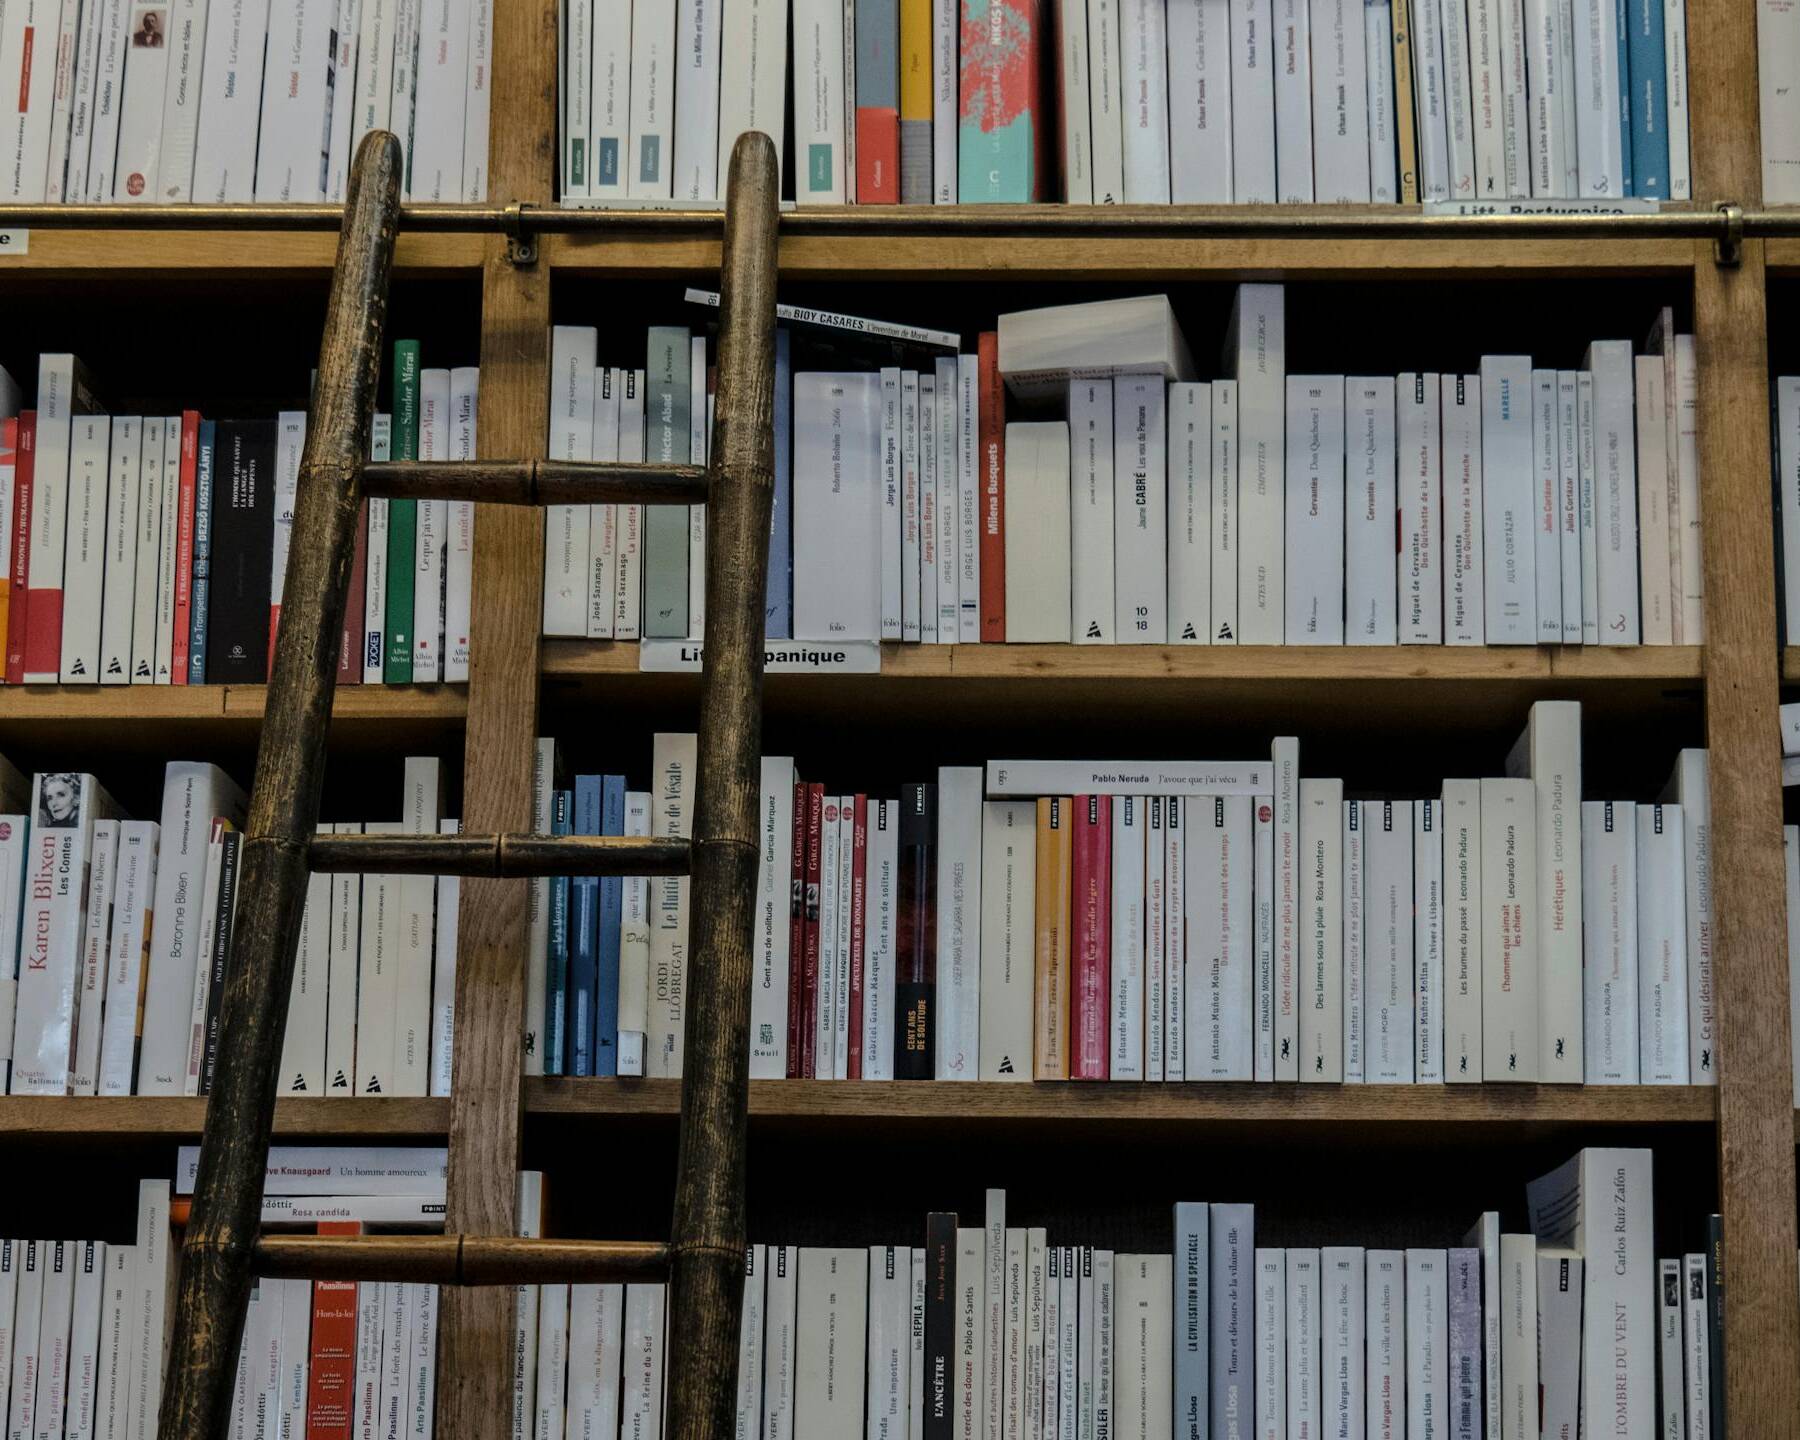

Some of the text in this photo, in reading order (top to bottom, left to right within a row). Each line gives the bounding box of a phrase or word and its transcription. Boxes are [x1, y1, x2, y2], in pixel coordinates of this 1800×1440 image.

[793, 308, 864, 330] BIOY CASARES
[401, 352, 414, 424] Sándor Márai
[661, 394, 673, 462] Héctor Abad
[886, 437, 895, 464] Borges
[199, 446, 211, 509] KOSZTOLÁNYI
[233, 461, 241, 474] QUI
[988, 444, 1000, 534] Milena Busquets
[1135, 473, 1146, 505] CABRÉ
[1501, 379, 1514, 555] CORTÁZAR MARELLE
[886, 484, 895, 506] Jorge
[628, 506, 636, 553] La lucidité
[924, 492, 934, 563] Jorge Luis Borges
[196, 543, 211, 577] tchèque
[1411, 533, 1421, 624] Miguel de Cervantes
[195, 579, 209, 633] Trompettiste
[592, 557, 604, 620] José Saramago
[1136, 607, 1148, 616] 10
[194, 635, 204, 645] Le
[369, 632, 379, 667] POCKET
[1136, 621, 1148, 630] 18
[764, 649, 845, 664] panique
[662, 763, 681, 818] de Vésale
[1092, 774, 1149, 783] Pablo Neruda
[57, 837, 72, 895] Les Contes
[1315, 840, 1324, 878] Montero
[1506, 826, 1516, 898] Leonardo Padura
[1551, 774, 1565, 931] Hérétiques Leonardo Padura
[29, 836, 55, 970] Karen Blixen
[1281, 760, 1293, 1015] L'idée ridicule de ne plus jamais te revoir Rosa Montero
[1315, 881, 1324, 901] Rosa
[1458, 828, 1470, 995] Les brumes du passé Leonardo Padura
[170, 872, 188, 958] Baronne Blixen
[1315, 907, 1326, 928] pluie
[1512, 904, 1521, 947] les chiens
[1695, 825, 1713, 1040] Ce qui désirait arriver Leonardo Padura
[86, 937, 98, 990] Karen Blixen
[765, 938, 772, 948] de
[1501, 905, 1514, 992] L'homme qui aimait
[657, 962, 669, 1001] JORDI
[670, 943, 682, 1021] LLOBREGAT
[1261, 951, 1270, 1031] FERNANDO MONACELLI
[1315, 962, 1324, 991] larmes
[917, 1000, 926, 1050] DE SOLITUDE
[1151, 982, 1160, 1062] Eduardo Mendoza
[1315, 994, 1324, 1009] Des
[907, 1010, 917, 1050] CENT ANS
[281, 1167, 331, 1178] Knausgaard
[292, 1208, 350, 1216] Rosa candida
[965, 1287, 973, 1314] Santis
[1031, 1266, 1042, 1332] Luis Sepúlveda
[1188, 1234, 1198, 1351] LA CIVILISATION DU SPECTACLE
[1614, 1168, 1627, 1435] L'OMBRE DU VENT Carlos Ruiz Zafón
[913, 1305, 922, 1336] REPILA
[964, 1330, 973, 1355] Pablo
[965, 1316, 973, 1327] de
[81, 1355, 91, 1389] infantil
[643, 1336, 652, 1412] La Reine du Sud
[934, 1356, 944, 1417] L'ANCÊTRE
[964, 1361, 972, 1389] douze
[416, 1367, 426, 1433] Arto Paasilinna
[964, 1391, 972, 1407] des
[1339, 1356, 1349, 1437] Mario Vargas Llosa
